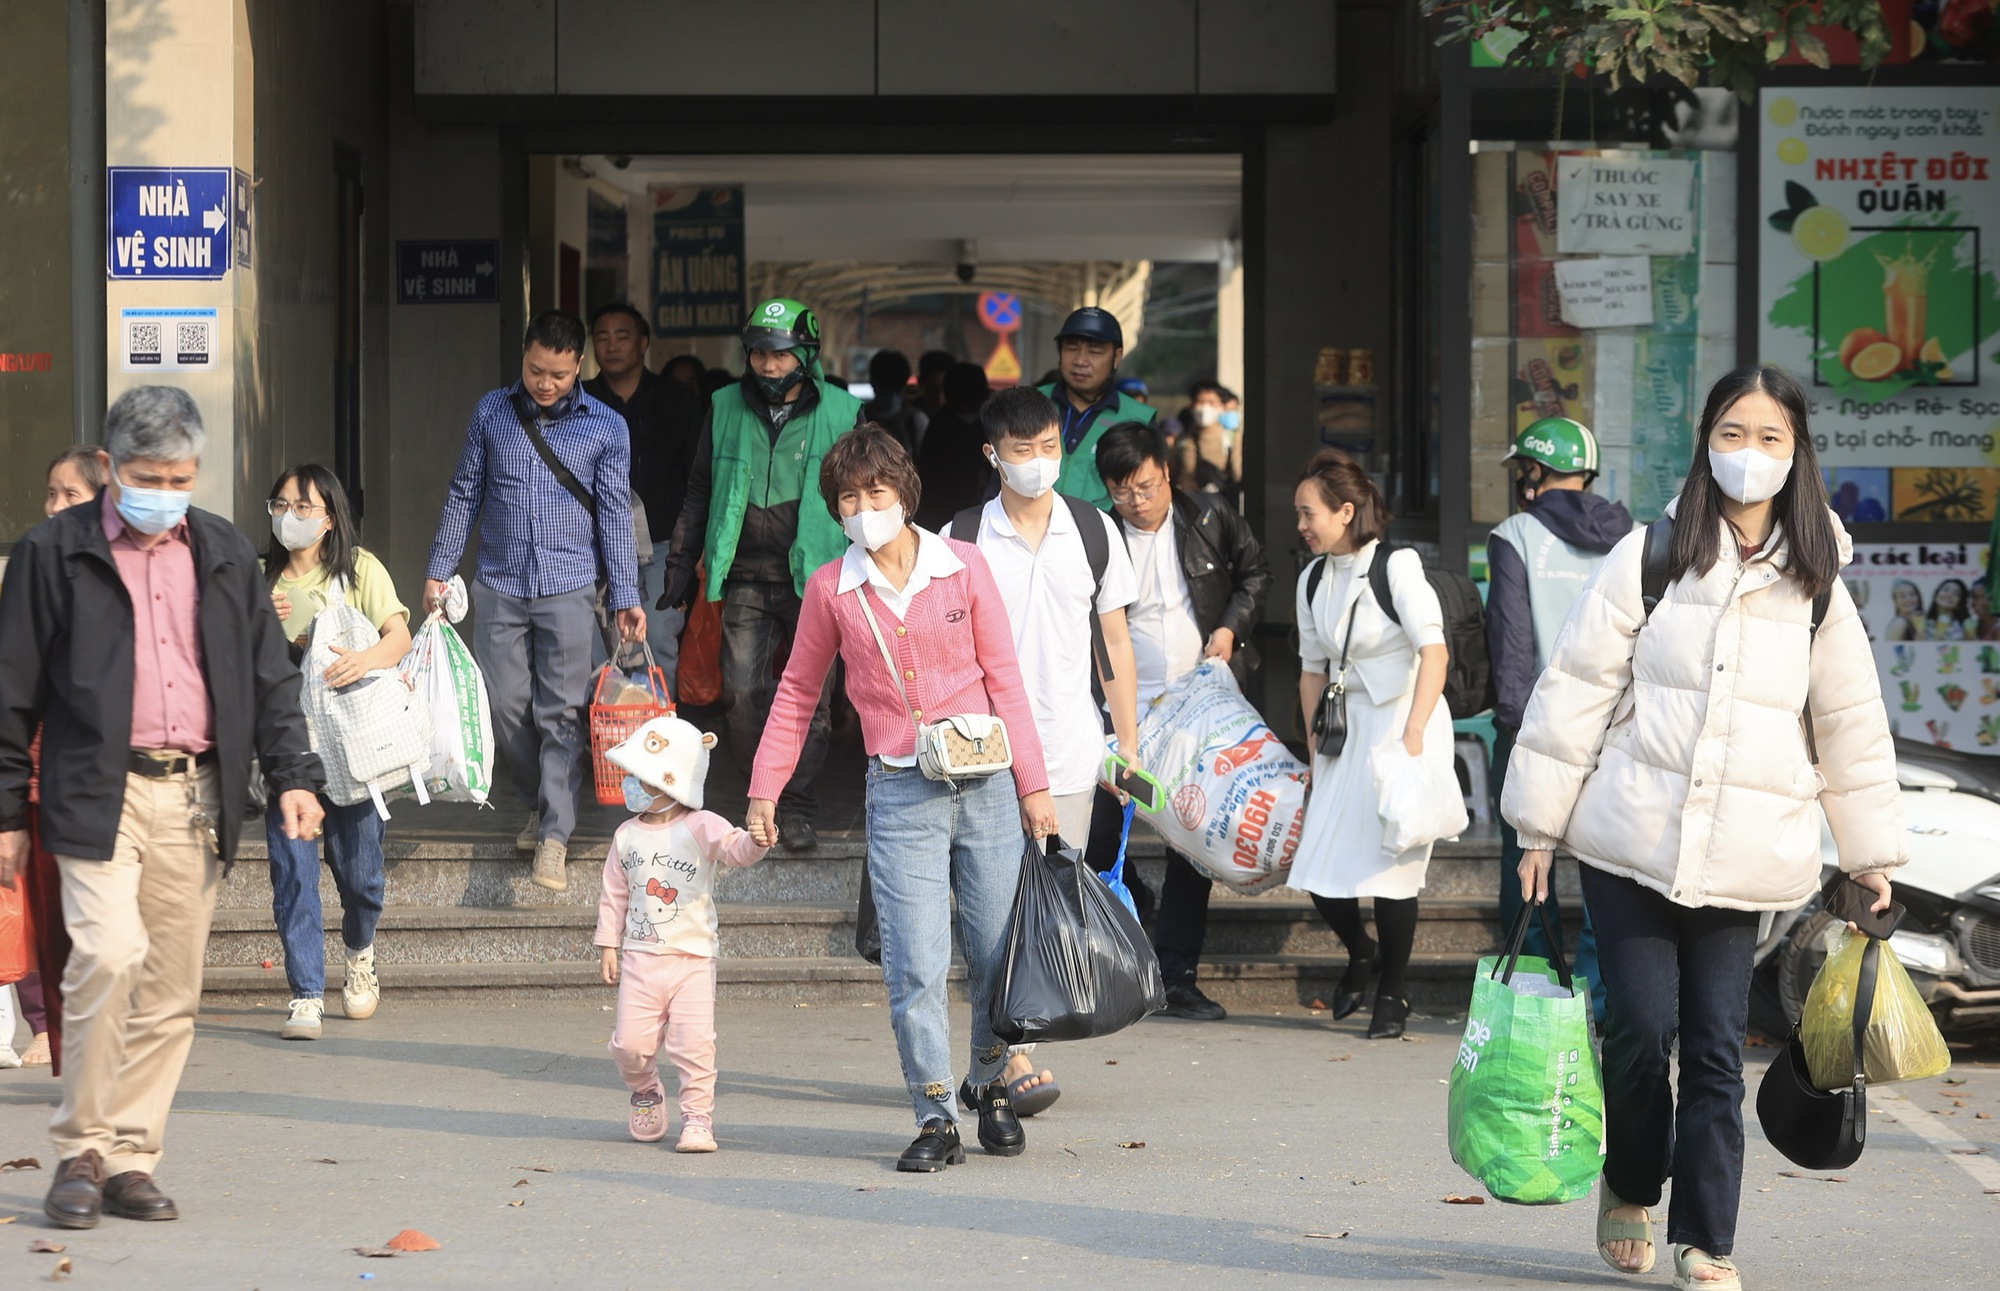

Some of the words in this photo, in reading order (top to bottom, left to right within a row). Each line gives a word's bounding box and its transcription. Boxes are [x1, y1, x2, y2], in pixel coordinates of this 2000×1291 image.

[1592, 167, 1660, 185] THUỐC
[1815, 151, 1918, 187] NHIỆT
[1926, 151, 1990, 181] ĐỚI
[139, 179, 190, 216] NHÀ
[1594, 191, 1632, 207] SAY
[1636, 193, 1662, 208] XE
[1858, 183, 1946, 214] QUÁN
[1583, 210, 1621, 229] TRÀ
[1626, 211, 1683, 231] GỪNG
[116, 230, 146, 275] VỆ
[153, 236, 211, 268] SINH
[421, 246, 459, 268] NHÀ
[405, 274, 426, 299] VỆ
[432, 278, 476, 295] SINH
[1524, 435, 1556, 456] Grab
[1834, 430, 1866, 452] tại
[1930, 430, 1994, 453] Mang
[1870, 547, 1911, 565] các
[1918, 543, 1967, 570] loại
[376, 742, 393, 752] HAZIN
[1233, 789, 1277, 869] H9030
[1271, 822, 1284, 837] ISO
[651, 852, 697, 882] Kitty
[1549, 1051, 1566, 1158] SimpleGreen.com
